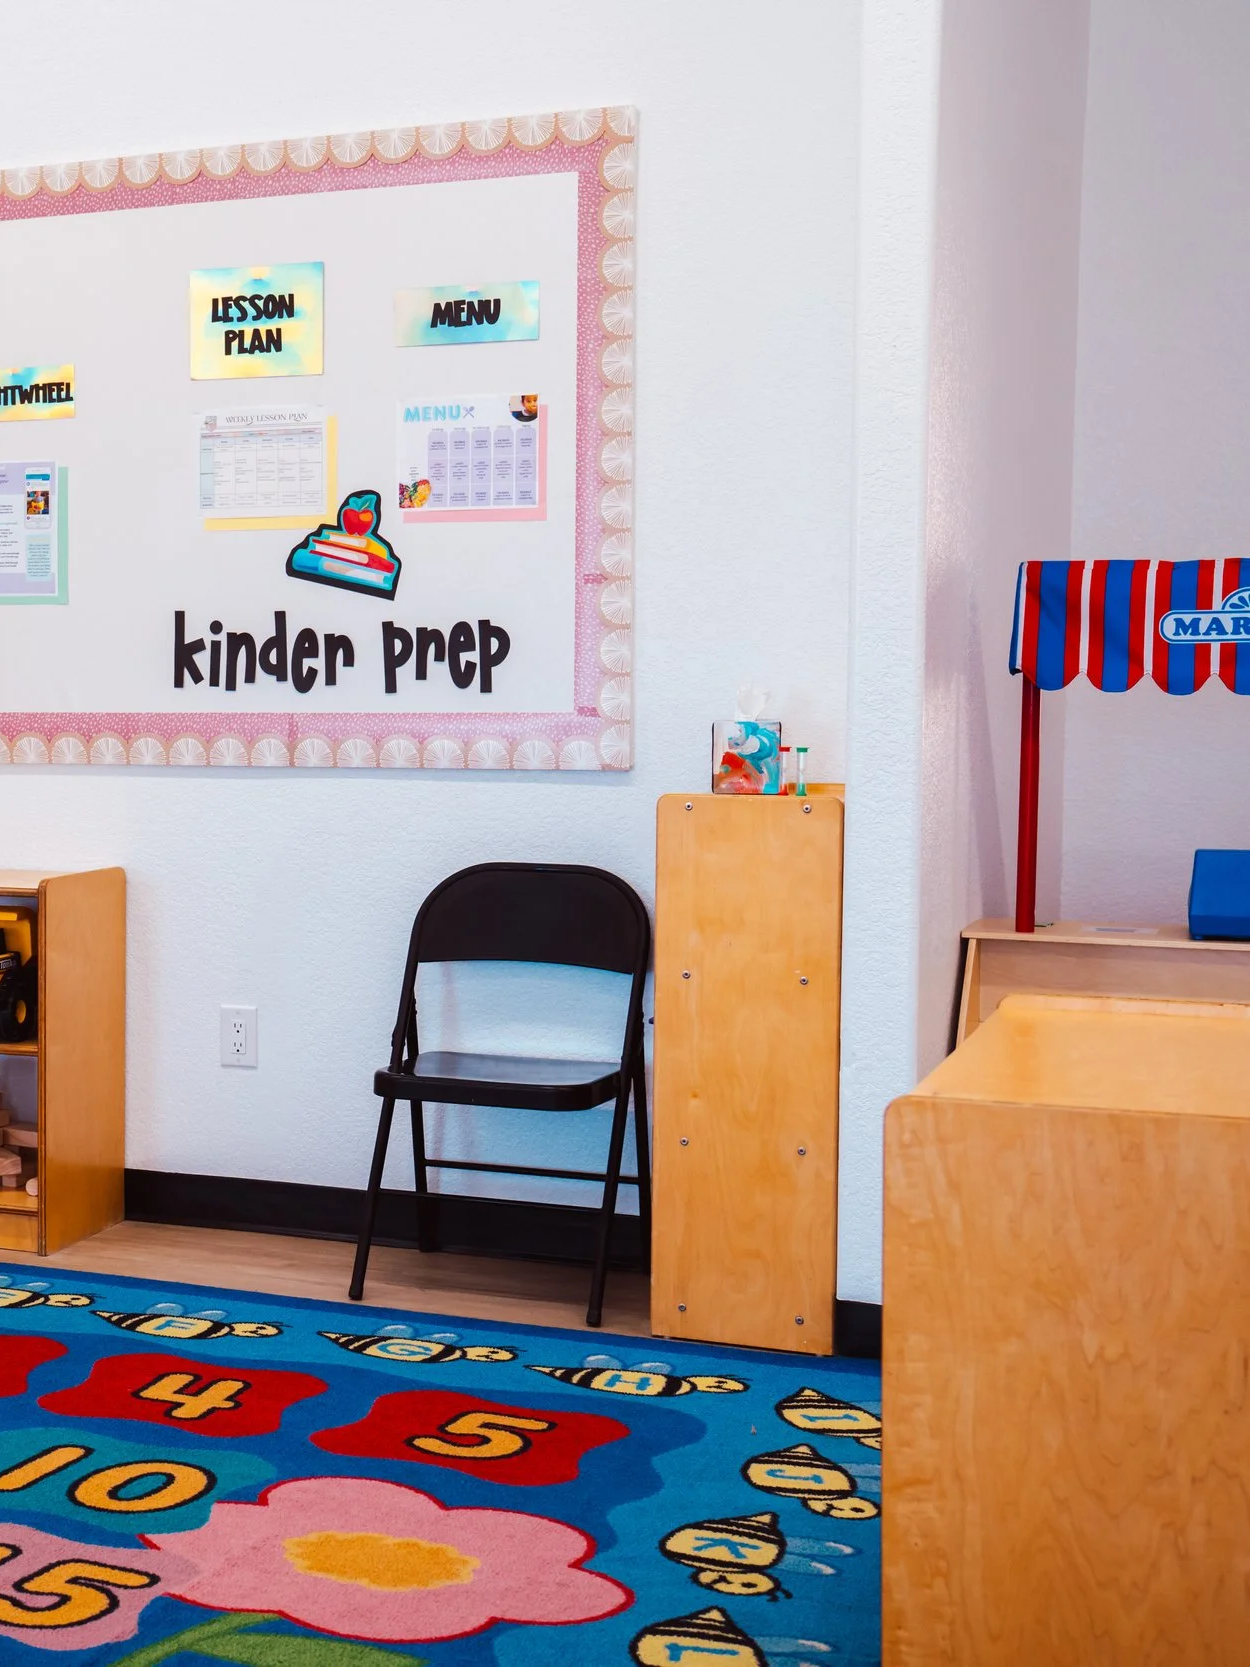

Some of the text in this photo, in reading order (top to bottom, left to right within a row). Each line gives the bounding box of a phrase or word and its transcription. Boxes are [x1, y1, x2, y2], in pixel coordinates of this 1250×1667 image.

[211, 293, 295, 323] LESSON
[430, 298, 501, 329] MENU
[224, 327, 282, 356] PLAN
[225, 412, 308, 426] WEEKLY LESSON PLAN
[403, 404, 461, 422] MENU
[173, 610, 511, 694] kinder prep
[152, 1318, 197, 1332] F
[375, 1341, 437, 1357] G
[602, 1371, 654, 1391] H
[133, 1370, 252, 1421] 4
[406, 1409, 556, 1461] 5
[765, 1468, 824, 1485] J
[693, 1535, 764, 1560] K
[664, 1642, 741, 1663] L
